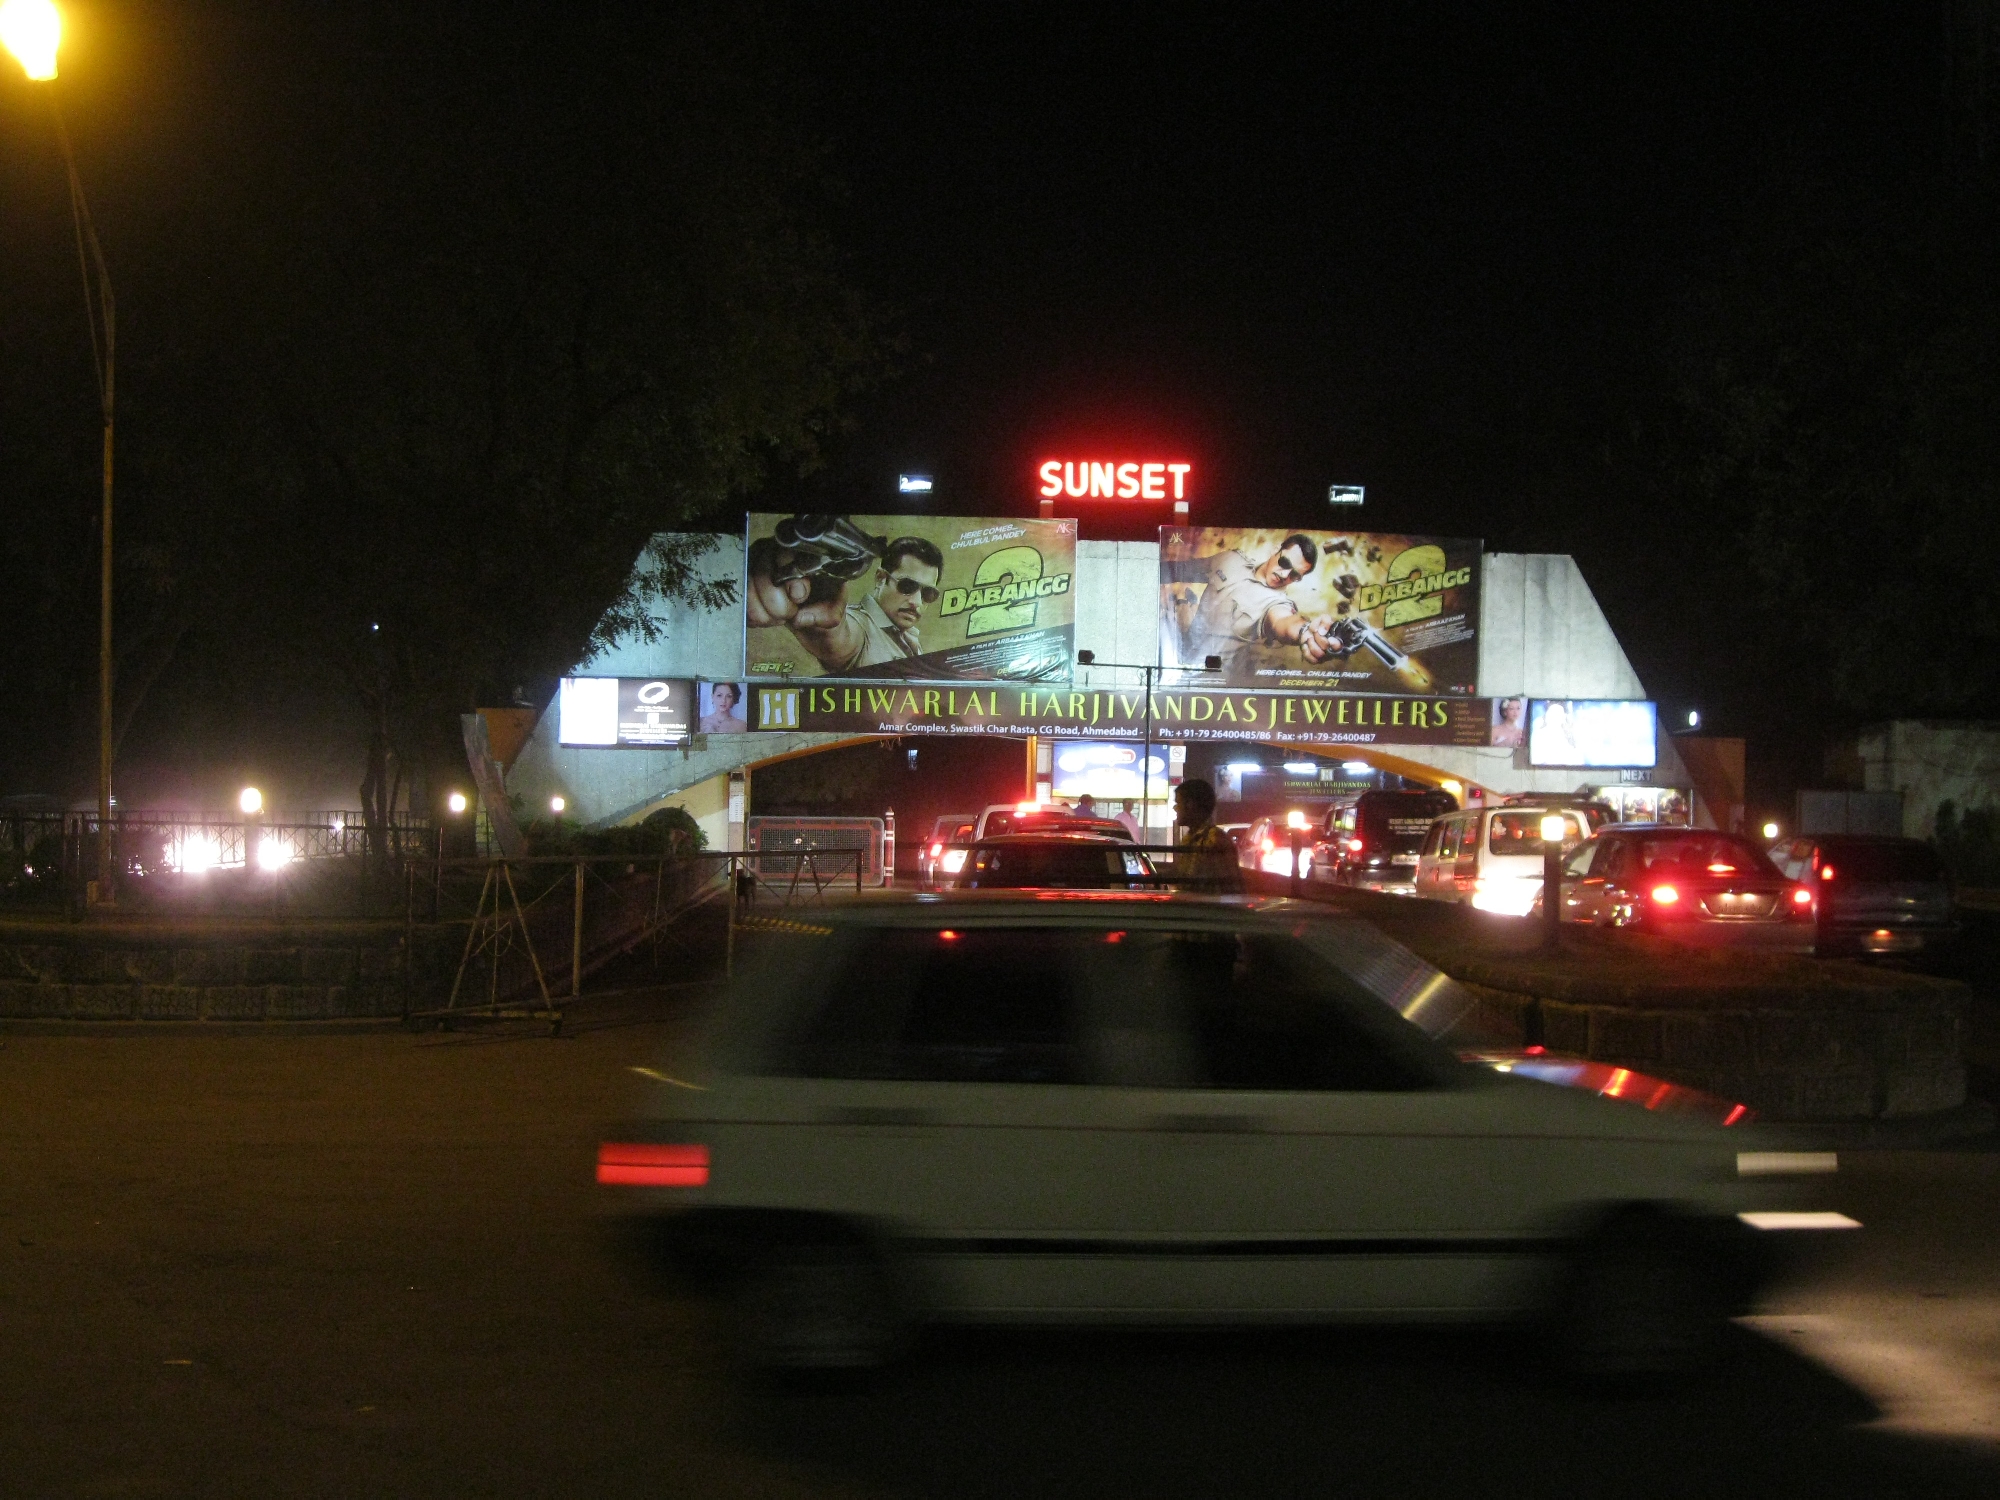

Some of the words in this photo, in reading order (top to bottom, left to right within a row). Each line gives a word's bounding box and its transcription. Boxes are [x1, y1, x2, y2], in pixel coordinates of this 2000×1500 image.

[1040, 461, 1190, 499] SUNSET
[951, 536, 991, 549] CHULBUL
[991, 529, 1026, 543] PANDEY
[960, 529, 982, 540] HERE
[940, 573, 1072, 617] DABANGG
[1359, 567, 1471, 612] DABANGG
[782, 661, 795, 673] 2
[1279, 679, 1325, 687] DECEMBER
[1325, 679, 1340, 687] 21
[809, 687, 1002, 718] ISHWARLAL
[1020, 692, 1258, 725] HARJIVANDAS
[1268, 698, 1449, 729] JEWELLERS
[879, 722, 904, 732] Amar
[905, 722, 949, 734] Complex,
[950, 723, 986, 733] Swastik
[987, 724, 1009, 734] Char
[1010, 725, 1038, 735] Rasta,
[1039, 726, 1053, 735] CG
[1054, 726, 1081, 736] Road,
[1082, 726, 1139, 736] Ahmedabad
[1159, 728, 1174, 738] Ph:
[1184, 729, 1210, 738] 91-79
[1211, 730, 1271, 740] 26400485/86
[1277, 731, 1296, 741] Fax:
[1298, 732, 1376, 742] +91-79-26400487
[1623, 769, 1652, 781] NEXT
